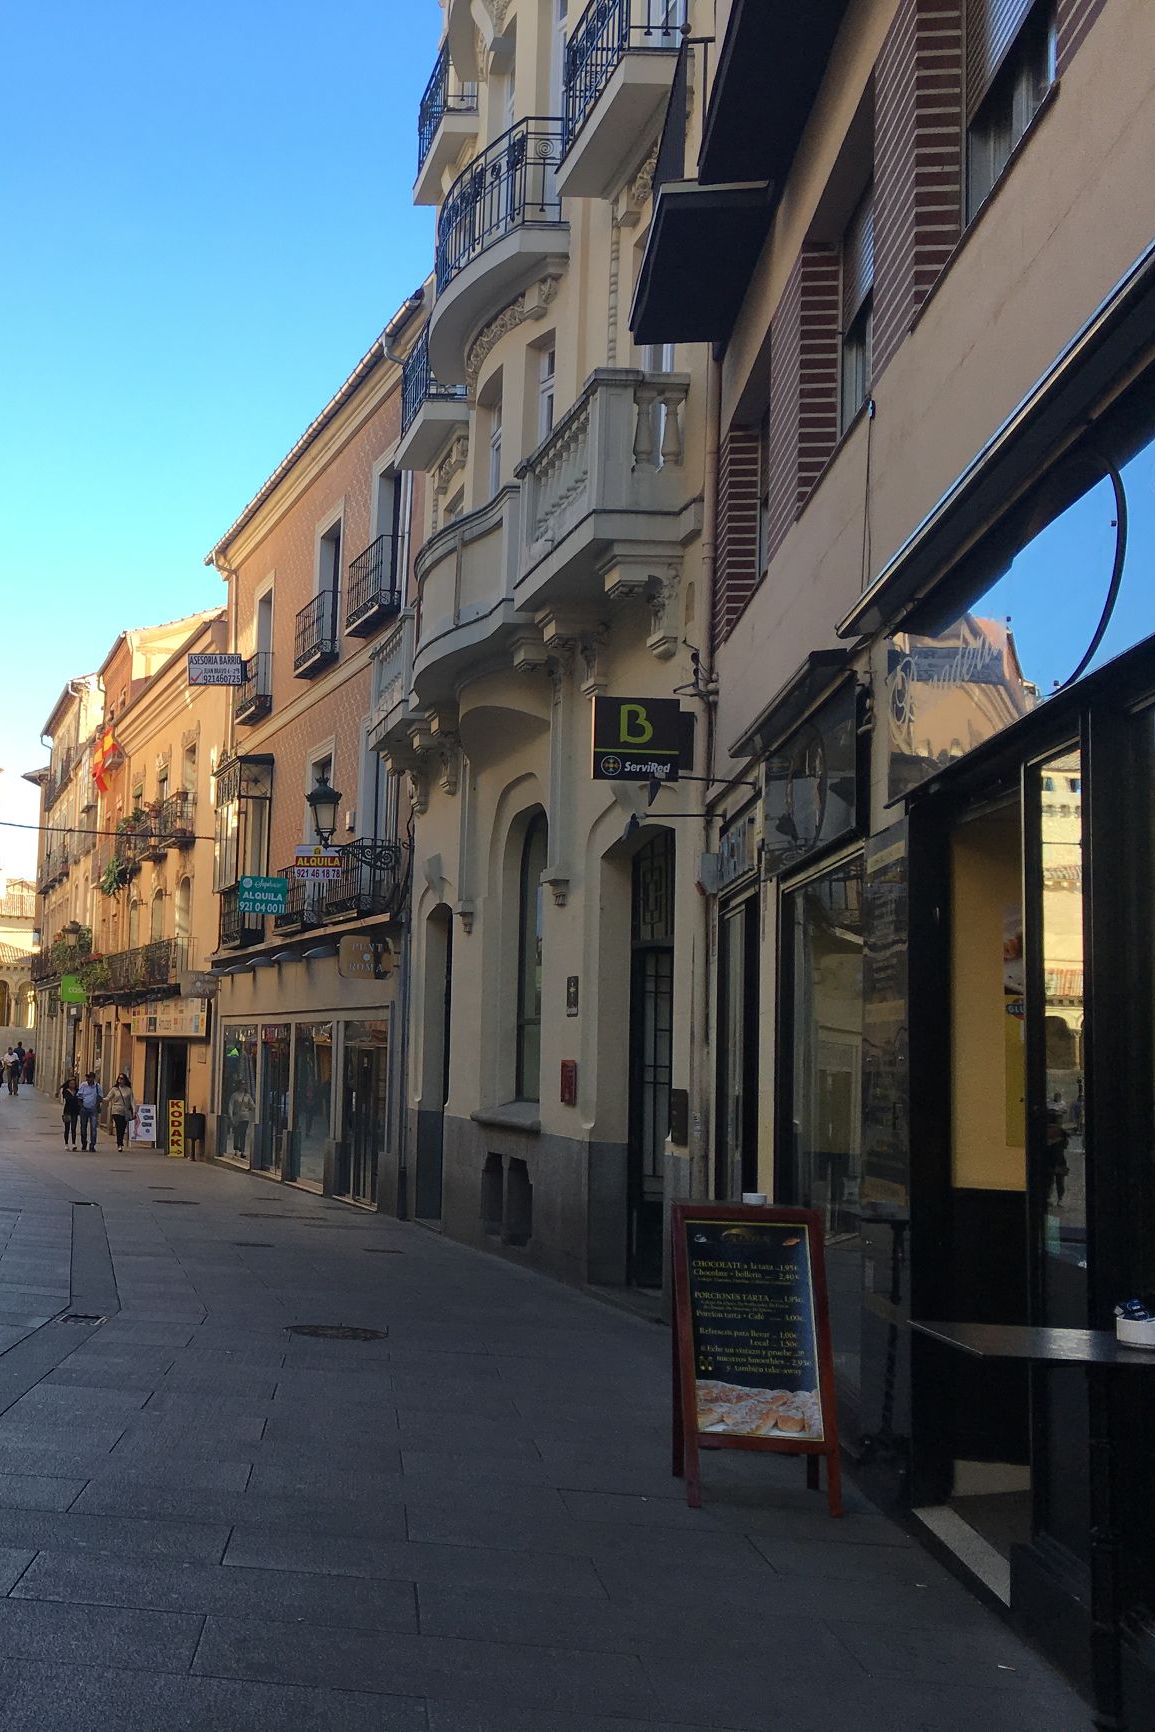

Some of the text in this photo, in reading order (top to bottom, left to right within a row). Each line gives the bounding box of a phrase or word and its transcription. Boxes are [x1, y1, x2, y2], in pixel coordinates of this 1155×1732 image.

[190, 656, 241, 665] ASESORIA BARRIO
[203, 674, 241, 684] 921460725
[620, 704, 654, 744] B
[624, 762, 671, 773] ServiRed
[297, 857, 340, 867] ALQUILA
[297, 869, 340, 878] 921 46 18 78
[243, 891, 283, 901] ALQUILA
[239, 901, 285, 914] 921 04 00 11
[349, 963, 383, 973] ROMA
[171, 1101, 183, 1147] KODAK
[693, 1261, 741, 1270] CHOCOLATE
[694, 1291, 741, 1300] PORCIONES
[742, 1294, 769, 1302] TARTA
